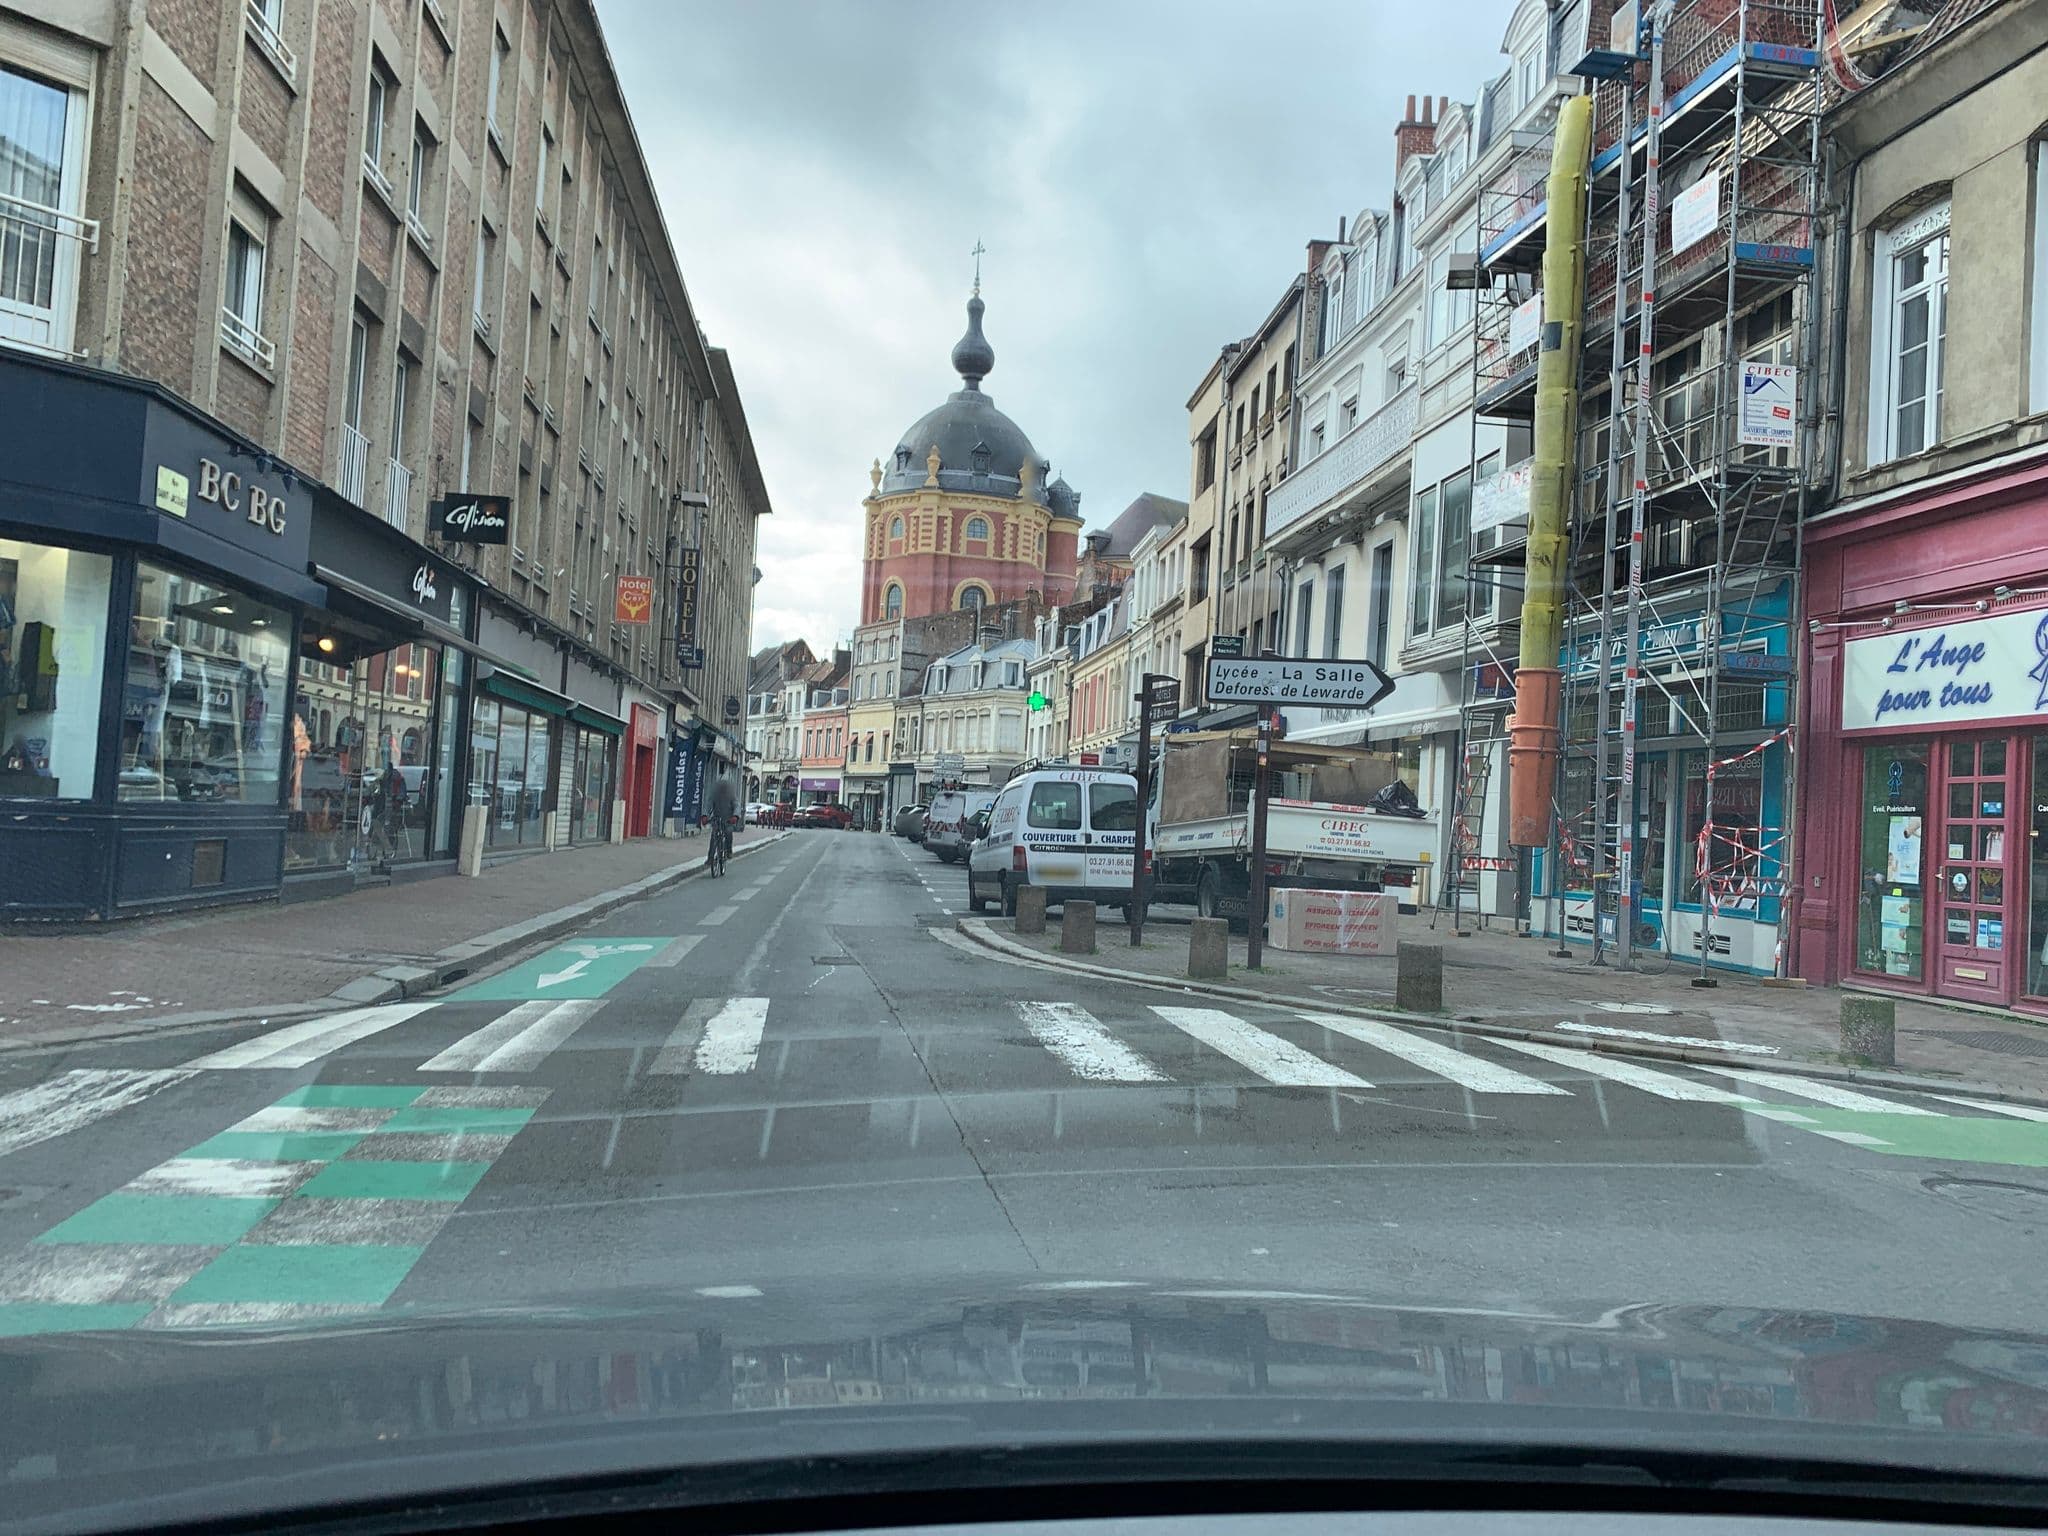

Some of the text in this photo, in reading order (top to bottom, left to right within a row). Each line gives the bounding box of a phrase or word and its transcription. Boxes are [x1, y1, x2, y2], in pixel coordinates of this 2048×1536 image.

[1648, 186, 1658, 222] CIBEC
[1756, 246, 1799, 260] CIBEC
[1747, 365, 1792, 377] CIBEC
[1641, 375, 1650, 409] CIBEC
[198, 457, 287, 536] BC BG
[445, 500, 505, 533] Collision
[619, 578, 651, 590] hotel
[682, 550, 696, 635] HOTEL
[1631, 561, 1642, 597] CIBEC
[1886, 633, 1986, 676] L'Ange
[1215, 664, 1259, 680] Lycée
[1282, 666, 1303, 680] La
[1315, 668, 1365, 682] Salle
[1281, 683, 1298, 697] de
[1302, 684, 1365, 699] Lewarde
[1875, 681, 1993, 722] pour tous
[672, 751, 687, 811] Leonidas
[1060, 772, 1107, 782] CIBEC
[1624, 748, 1634, 785] CIBEC
[1022, 832, 1077, 843] COUVERTURE
[1321, 819, 1369, 833] CIBEC
